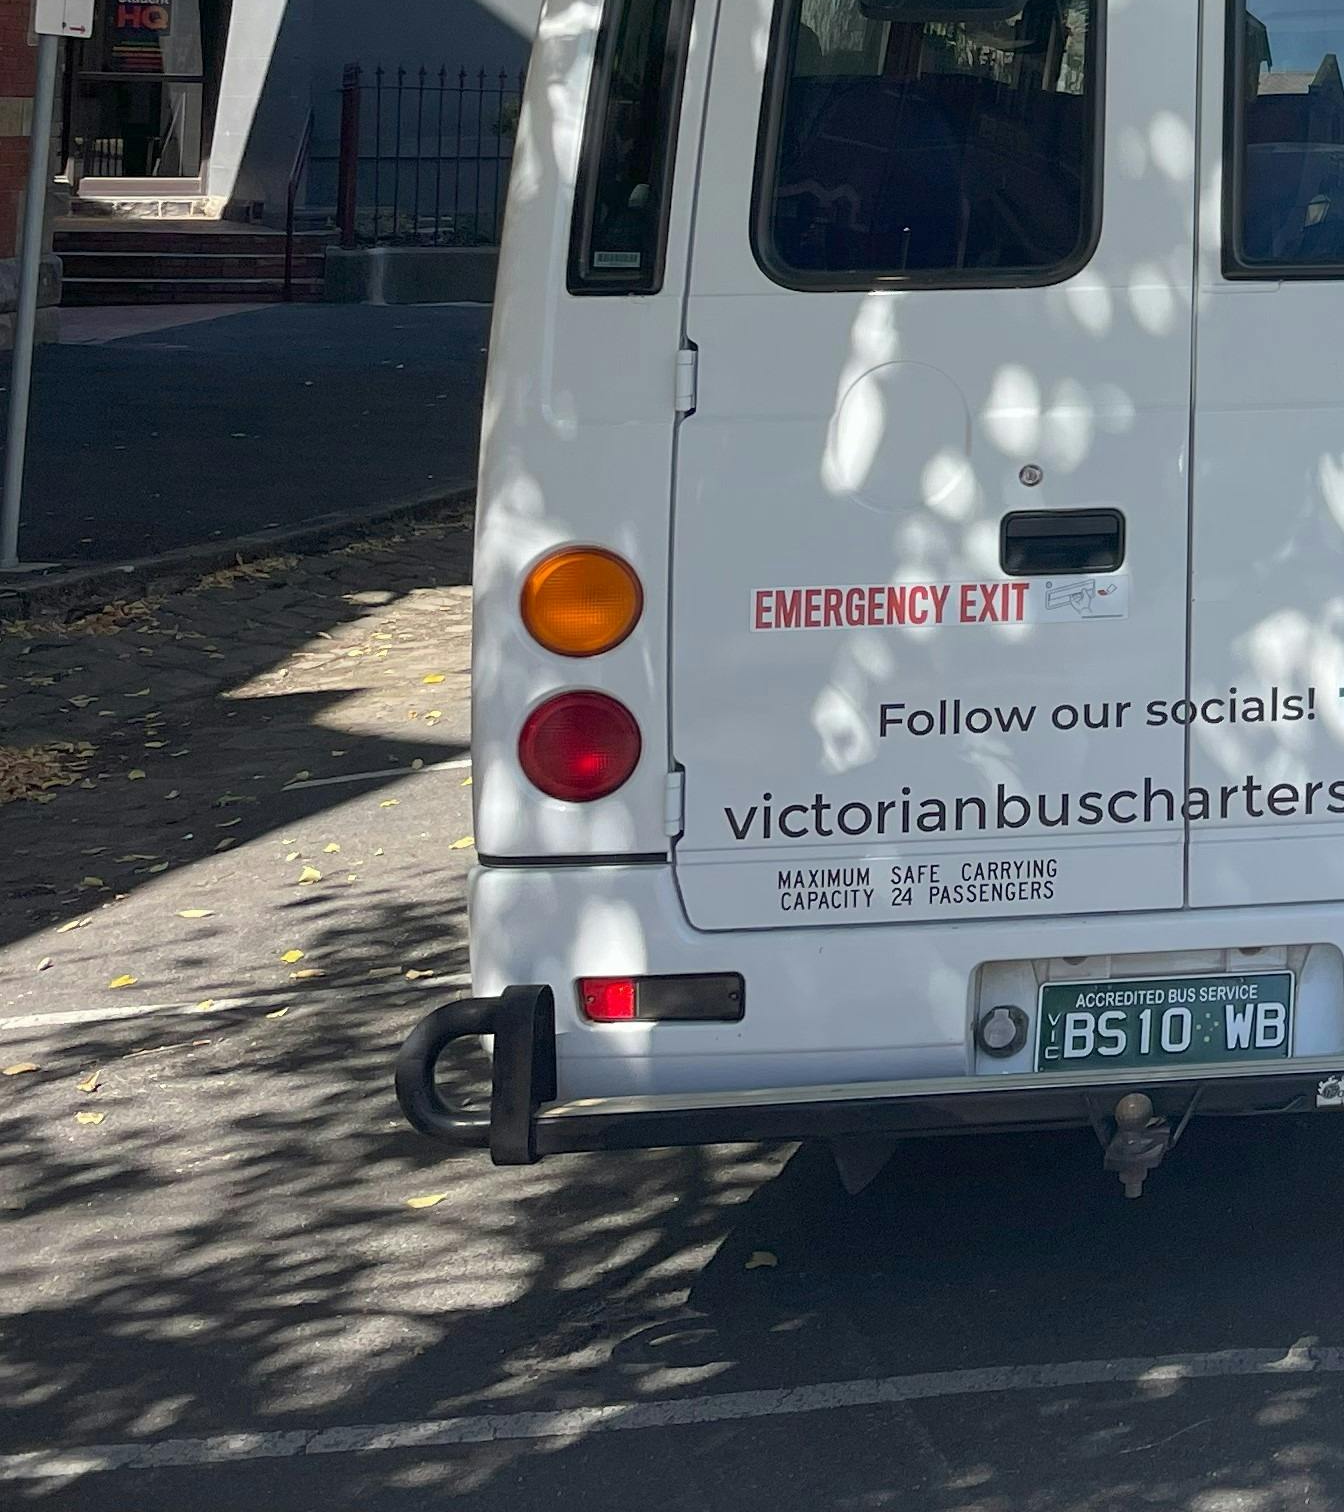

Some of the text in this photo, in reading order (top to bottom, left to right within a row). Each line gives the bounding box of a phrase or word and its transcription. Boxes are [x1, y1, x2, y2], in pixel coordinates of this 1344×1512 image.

[116, 5, 169, 30] HQ
[755, 582, 1030, 630] EMERGENCY EXIT
[879, 699, 1037, 738] Follow
[1051, 702, 1131, 730] our
[1146, 686, 1315, 727] socials!
[778, 859, 1058, 890] MAXIMUM SAFE CARRYING
[780, 881, 1055, 911] CAPACITY 24 PASSENGERS
[1075, 984, 1259, 1008] ACCREDITED BUS SERVICE
[1044, 1013, 1062, 1059] VIC
[1225, 1002, 1287, 1050] WB
